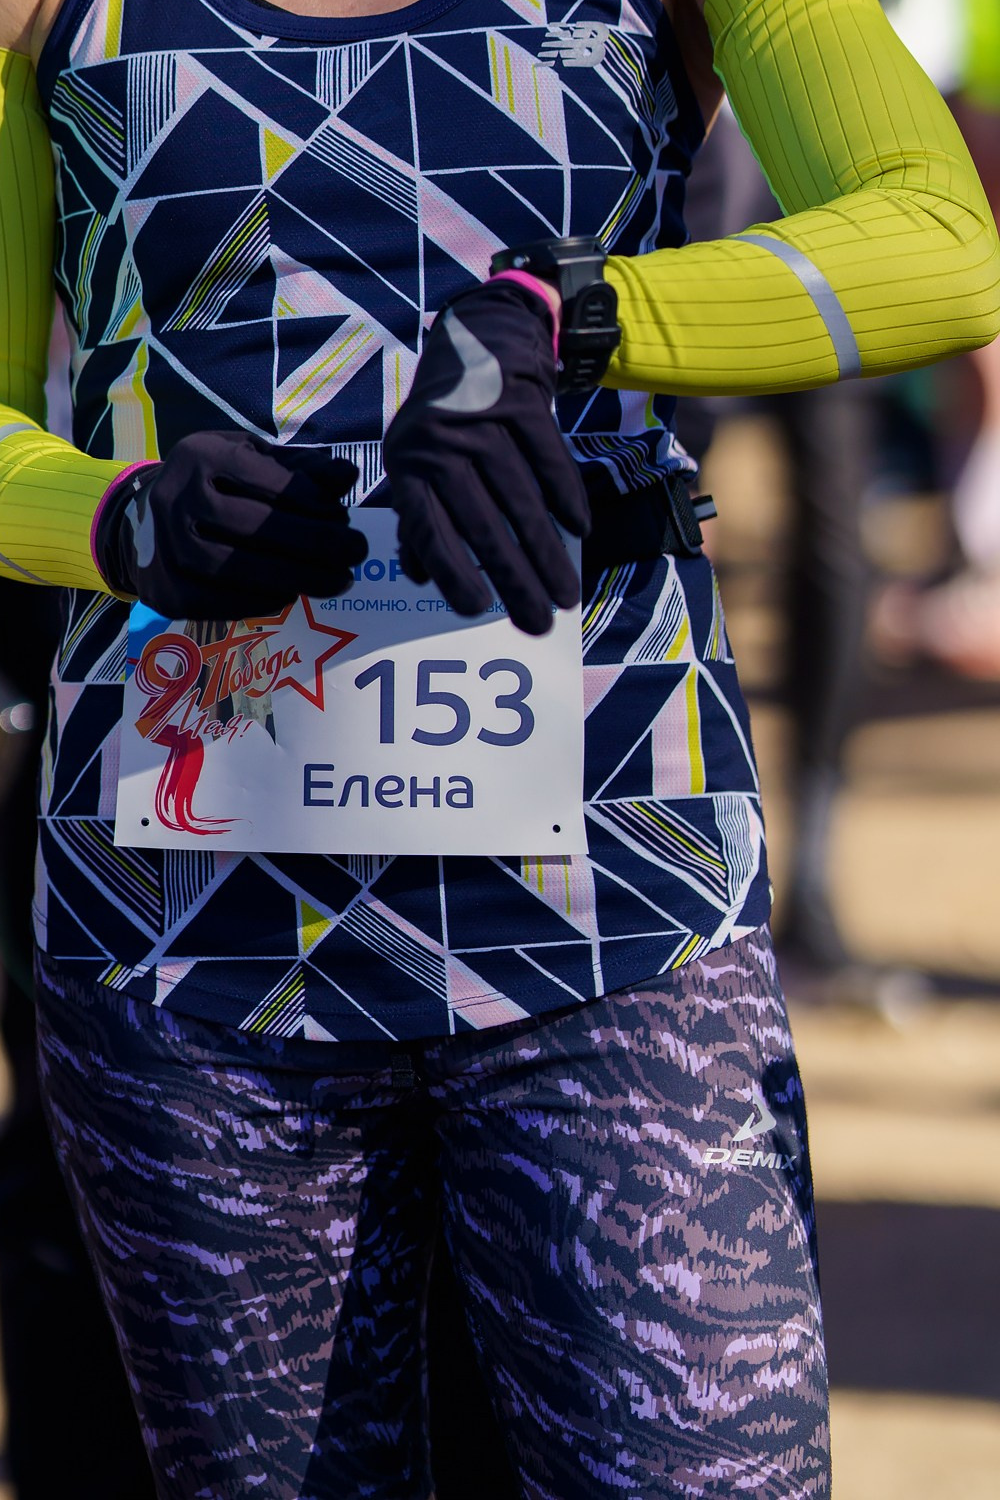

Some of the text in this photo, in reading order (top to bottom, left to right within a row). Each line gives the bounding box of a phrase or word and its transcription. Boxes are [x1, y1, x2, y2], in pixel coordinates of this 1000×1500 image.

[319, 599, 337, 611] «Я
[341, 599, 412, 612] ПОМНЮ.
[354, 658, 536, 748] 153
[303, 763, 475, 810] Елена
[702, 1147, 798, 1172] DEMIX
